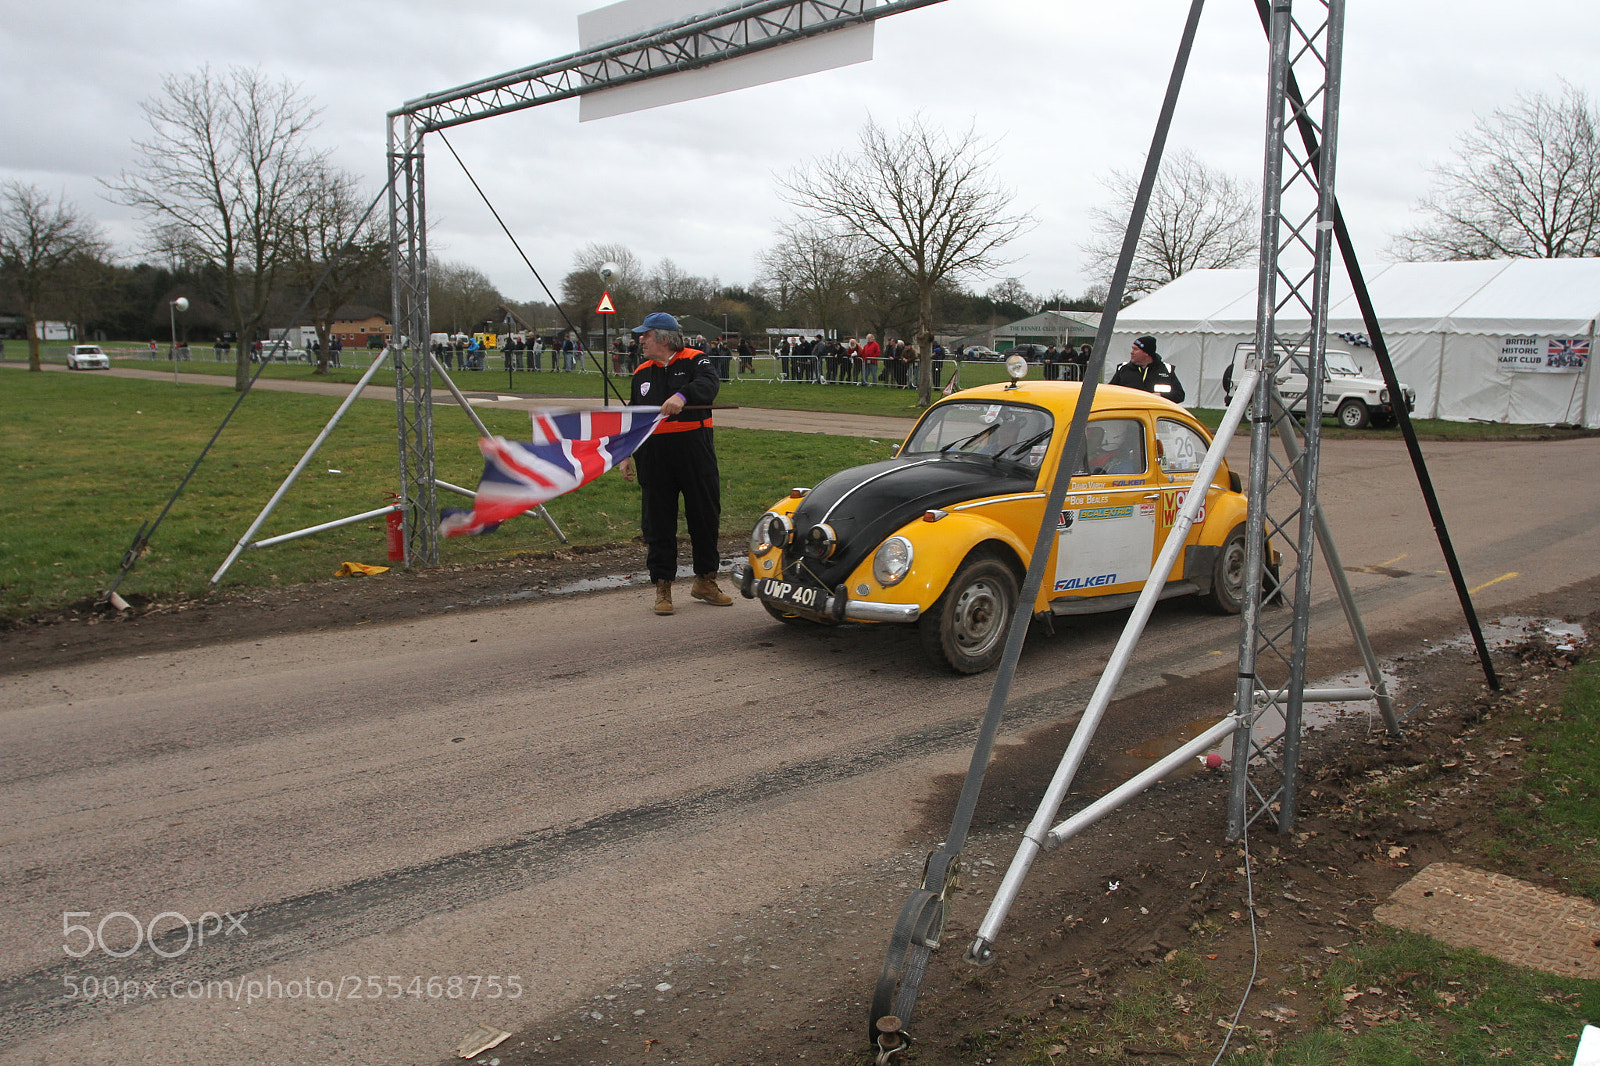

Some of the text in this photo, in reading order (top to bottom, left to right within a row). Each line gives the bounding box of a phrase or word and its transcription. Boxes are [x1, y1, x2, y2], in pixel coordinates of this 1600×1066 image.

[1175, 436, 1193, 459] 26
[1070, 495, 1084, 505] BOB
[1086, 495, 1109, 504] BEALES
[1080, 507, 1132, 518] SCALEXTRIC
[1054, 573, 1117, 591] FALKEN
[764, 579, 818, 607] UWP 401
